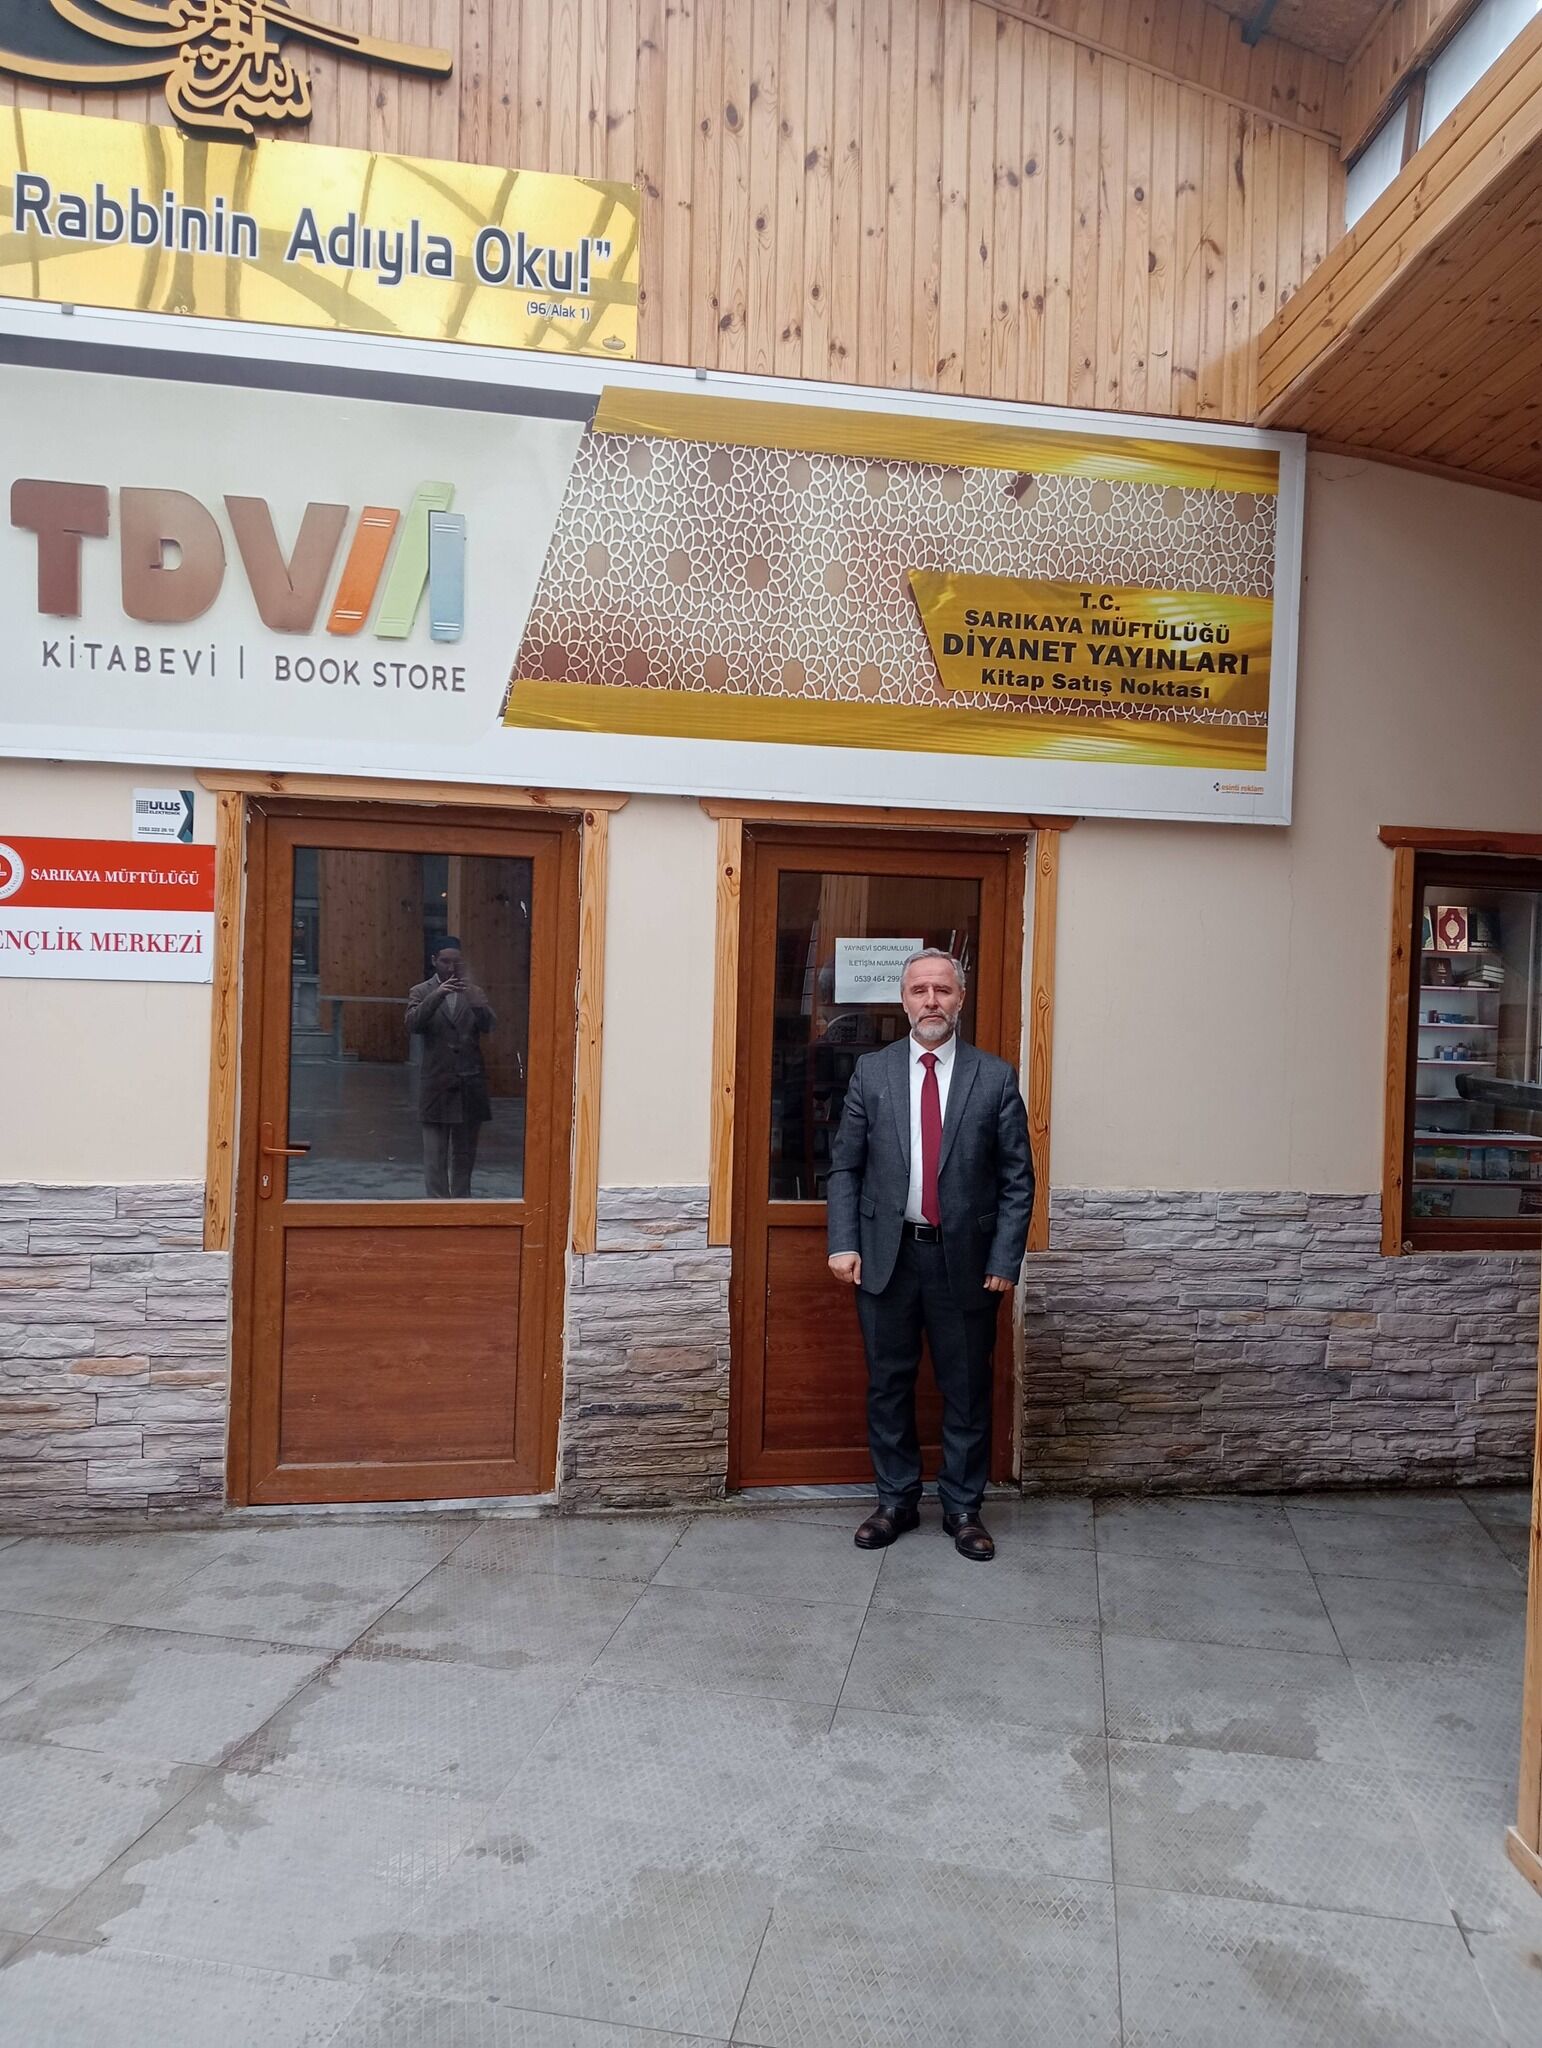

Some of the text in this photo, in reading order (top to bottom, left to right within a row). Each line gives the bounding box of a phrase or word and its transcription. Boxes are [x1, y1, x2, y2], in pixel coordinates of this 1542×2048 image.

[13, 173, 259, 259] Rabbinin
[286, 206, 454, 286] Adıyla
[526, 301, 591, 321] (96/Alak 1)
[10, 478, 350, 636] TDV
[1080, 591, 1121, 612] T.C.
[964, 609, 1231, 645] SARIKAYA MÜFTÜLÜĞÜ
[41, 634, 467, 692] KİTABEVİ BOOK STORE
[942, 629, 1250, 676] DİYANET YAYINLARI
[981, 667, 1210, 700] Kitap Satış Noktası
[149, 800, 181, 812] ULUS
[30, 868, 200, 886] SARIKAYA MÜFTÜLÜĞÜ
[0, 926, 203, 956] NÇLİK MERKEZİ
[872, 944, 914, 952] SORUMLUSU
[876, 959, 906, 967] NUMARA
[854, 975, 903, 983] 0539 464 299
